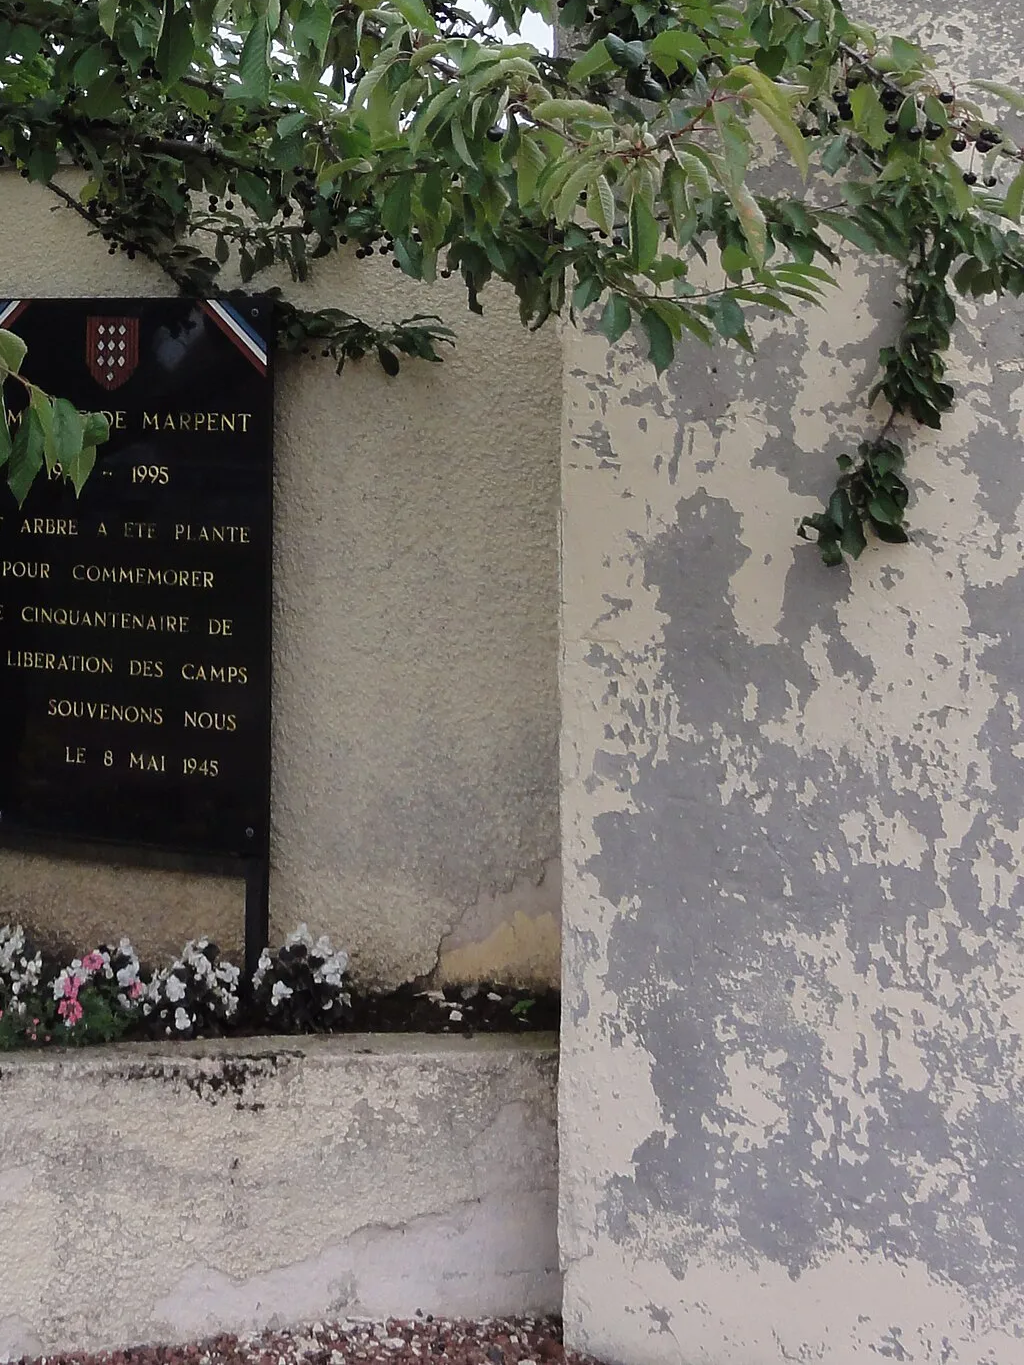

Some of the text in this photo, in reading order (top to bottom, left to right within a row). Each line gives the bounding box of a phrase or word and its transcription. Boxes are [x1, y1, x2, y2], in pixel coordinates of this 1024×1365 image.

[142, 411, 252, 433] MARPENT
[132, 464, 169, 485] 1995
[20, 518, 79, 536] ARBRE
[98, 521, 108, 536] A
[175, 523, 250, 544] PLANTE
[2, 560, 214, 589] POUR COMMEMORER
[21, 606, 190, 633] CINQUANTENAIRE
[208, 618, 233, 636] DE
[7, 650, 113, 674] LIBERATION
[129, 659, 164, 678] DES
[181, 663, 248, 685] CAMPS
[47, 698, 237, 732] SOUVENONS NOUS
[65, 746, 219, 777] LE 8 MAI 1945
